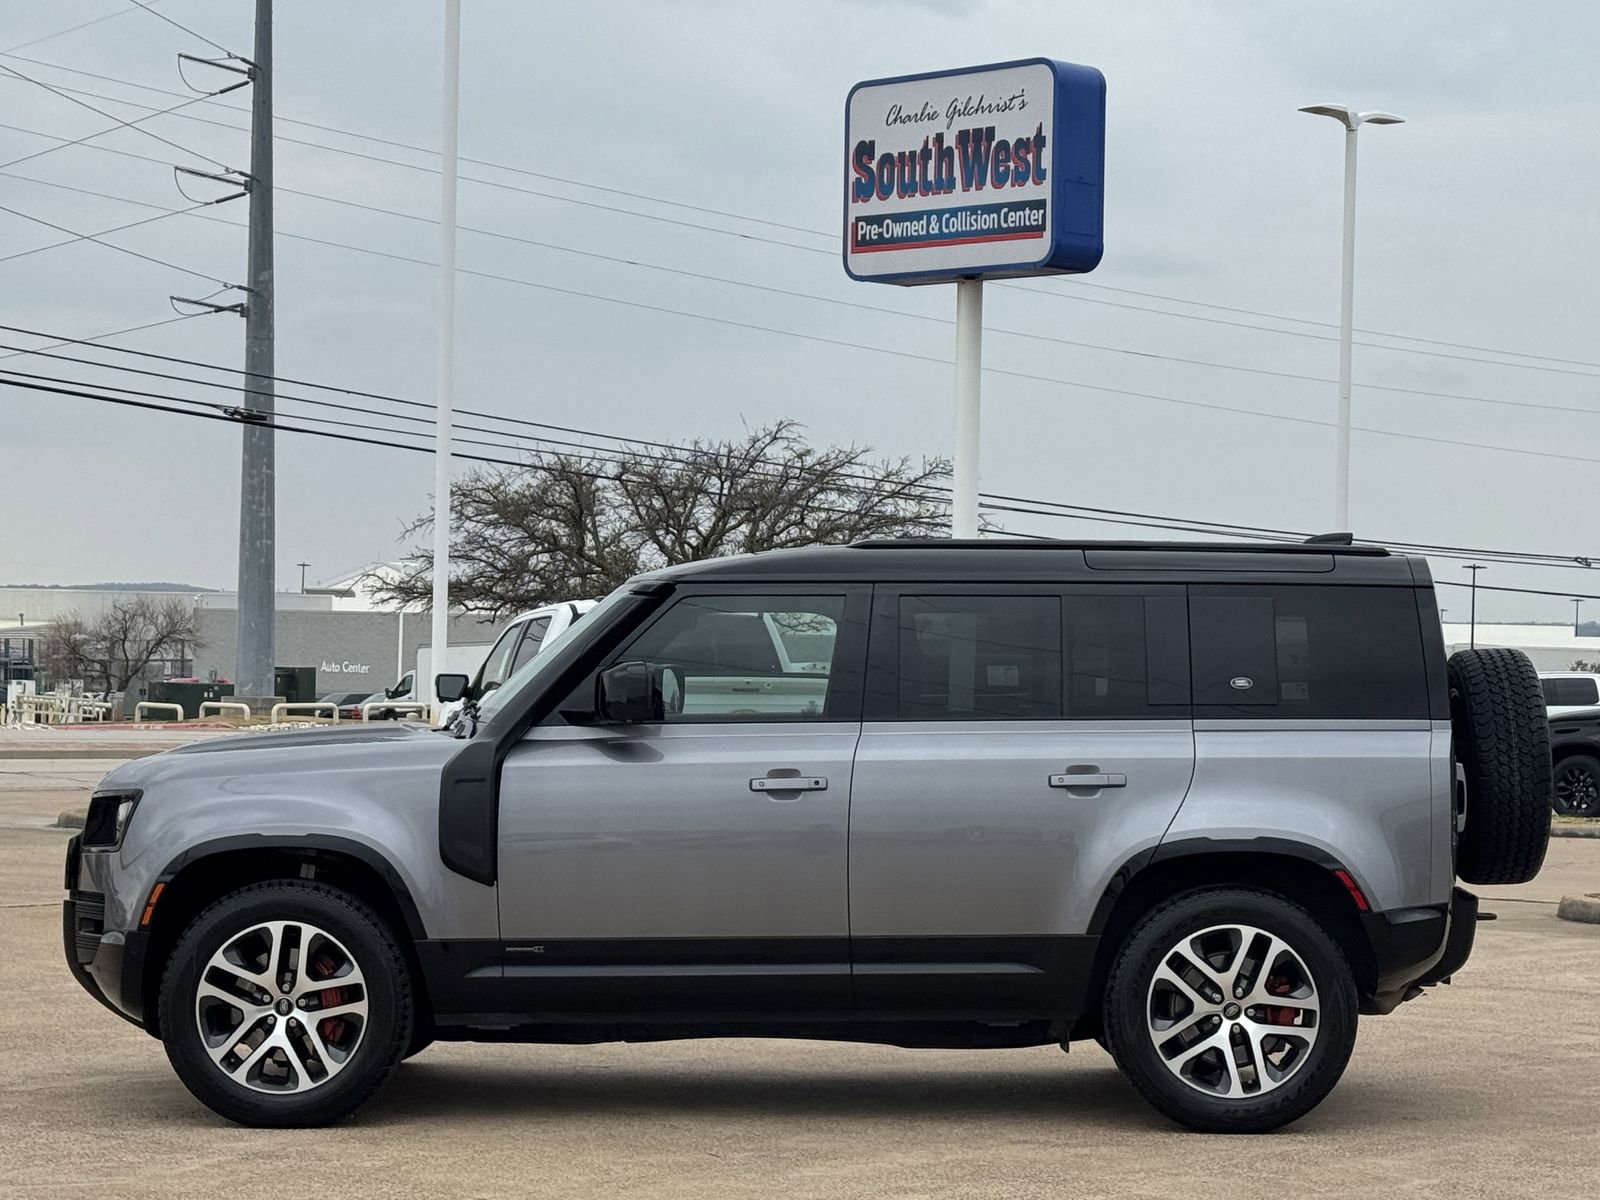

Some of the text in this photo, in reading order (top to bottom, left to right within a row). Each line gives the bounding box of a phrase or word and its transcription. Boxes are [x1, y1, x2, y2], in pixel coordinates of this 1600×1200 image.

[885, 88, 1028, 129] Charlie Gilchrist's
[857, 206, 1045, 241] Pre-Owned & Collision Center
[320, 660, 370, 674] Auto Center
